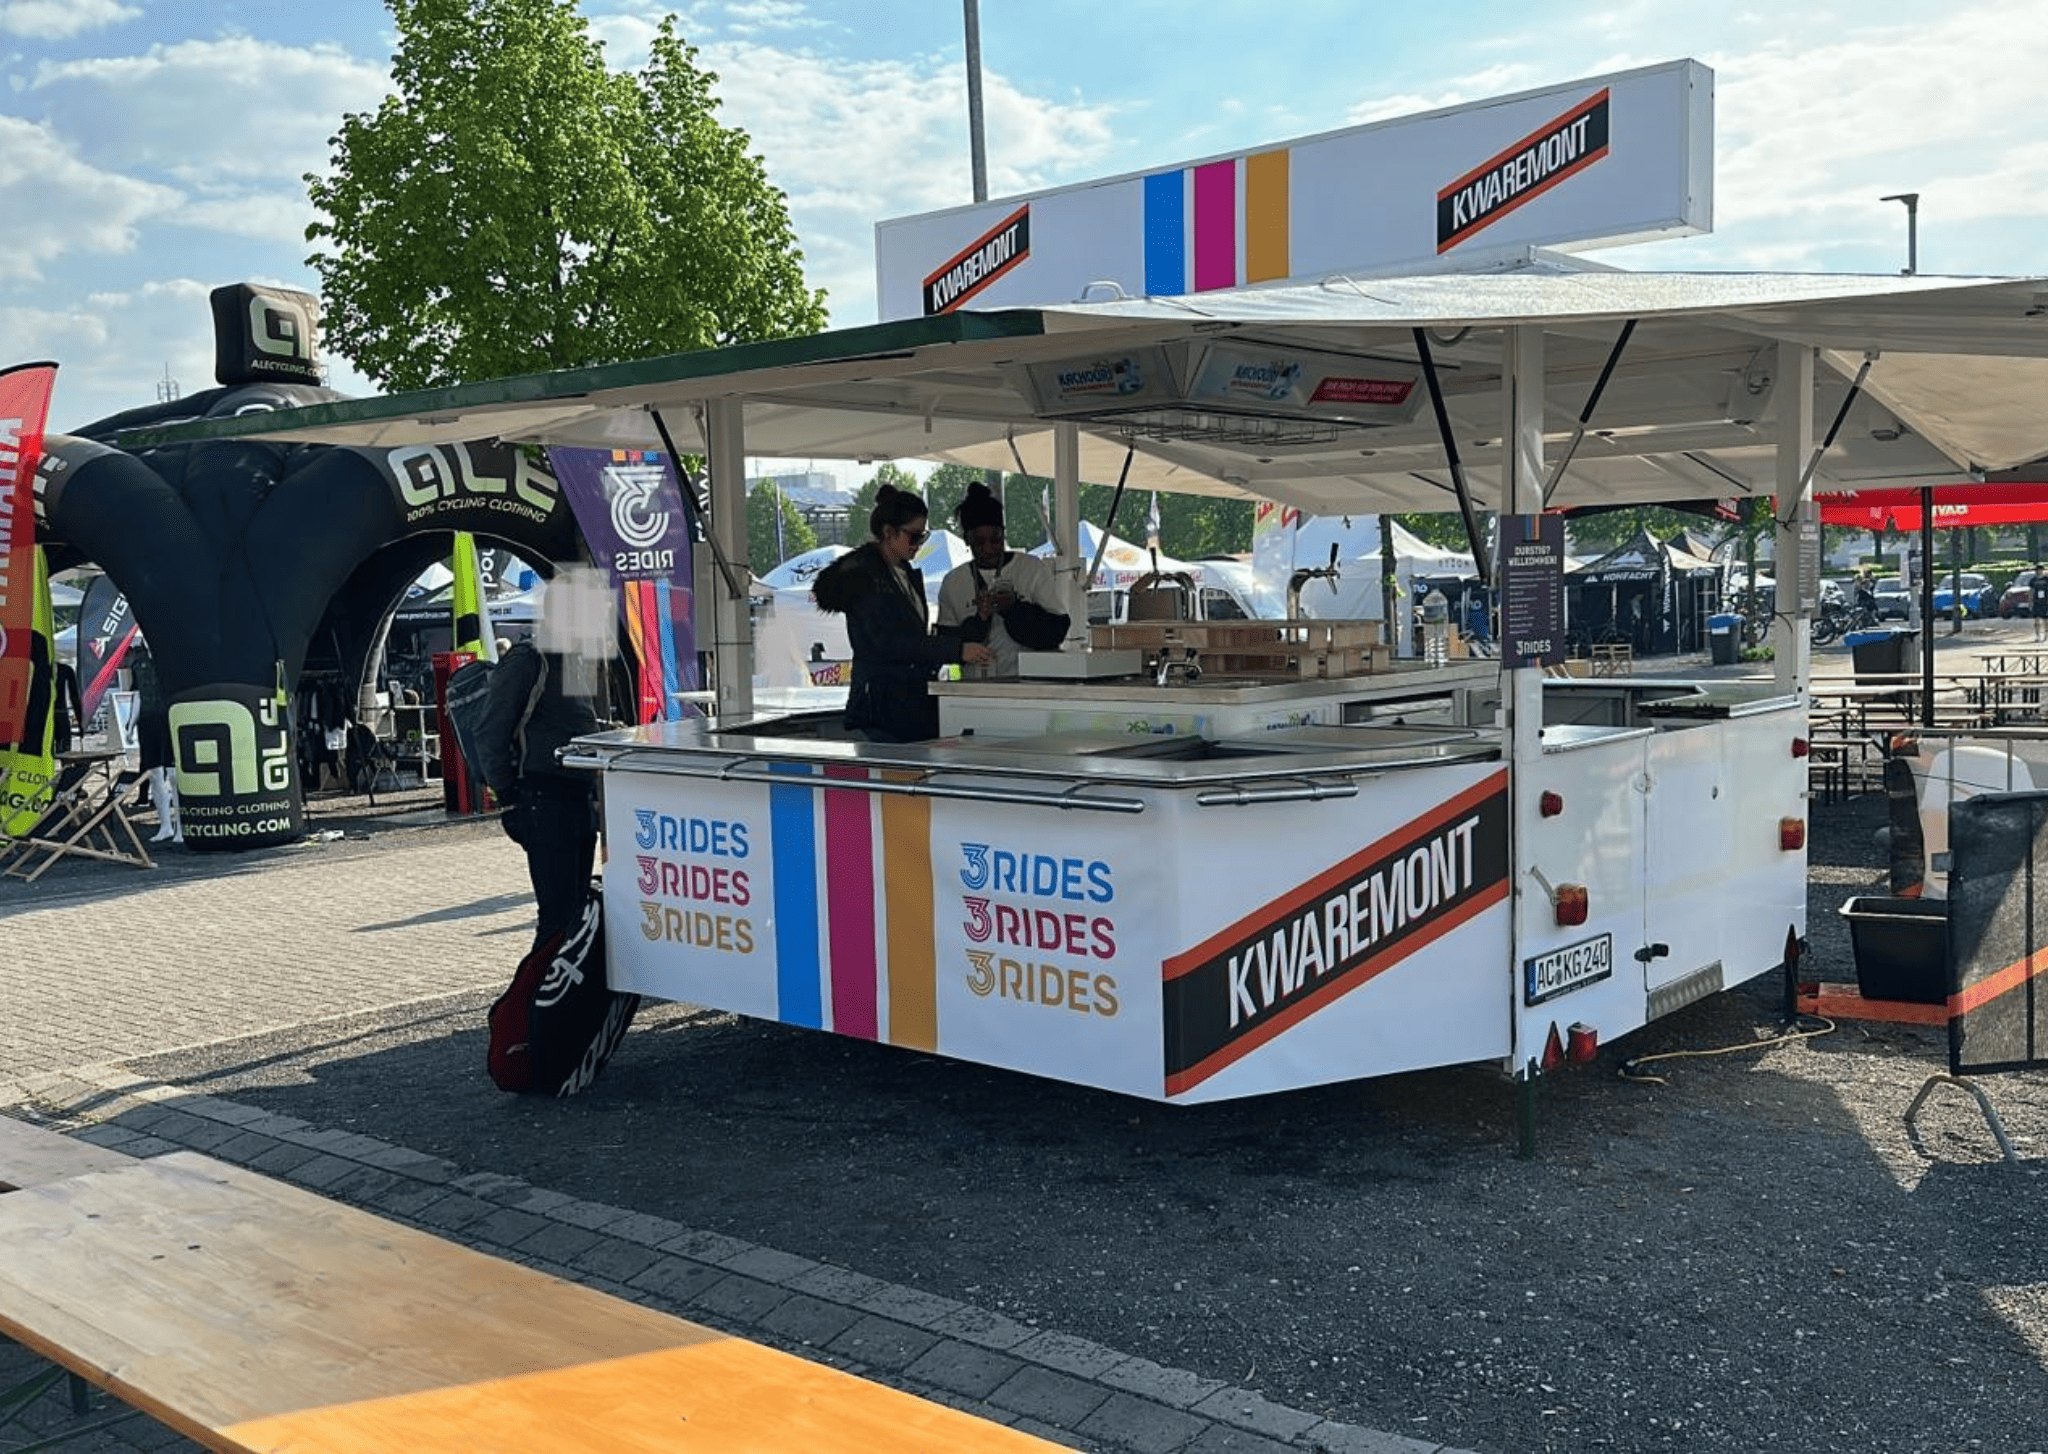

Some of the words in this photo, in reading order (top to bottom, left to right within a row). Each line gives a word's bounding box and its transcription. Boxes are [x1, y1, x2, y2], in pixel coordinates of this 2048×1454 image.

[1453, 114, 1591, 230] KWAREMONT
[933, 223, 1019, 311] KWAREMONT
[407, 504, 434, 522] 100%
[437, 496, 486, 512] CYCLING
[489, 498, 547, 523] CLOTHING
[1507, 555, 1558, 567] WILLKOMMEN!
[1514, 545, 1551, 556] DURSTIG?
[236, 800, 291, 815] CLOTHING
[634, 809, 749, 859] 3RIDES
[636, 855, 751, 906] 3RIDES
[960, 842, 1114, 903] 3RIDES
[639, 900, 754, 954] 3RIDES
[962, 895, 1117, 959] 3RIDES
[1228, 815, 1480, 1029] KWAREMONT
[965, 949, 1119, 1017] 3RIDES
[1537, 959, 1554, 990] AC
[1563, 949, 1582, 981] KG
[1583, 940, 1608, 973] 240
